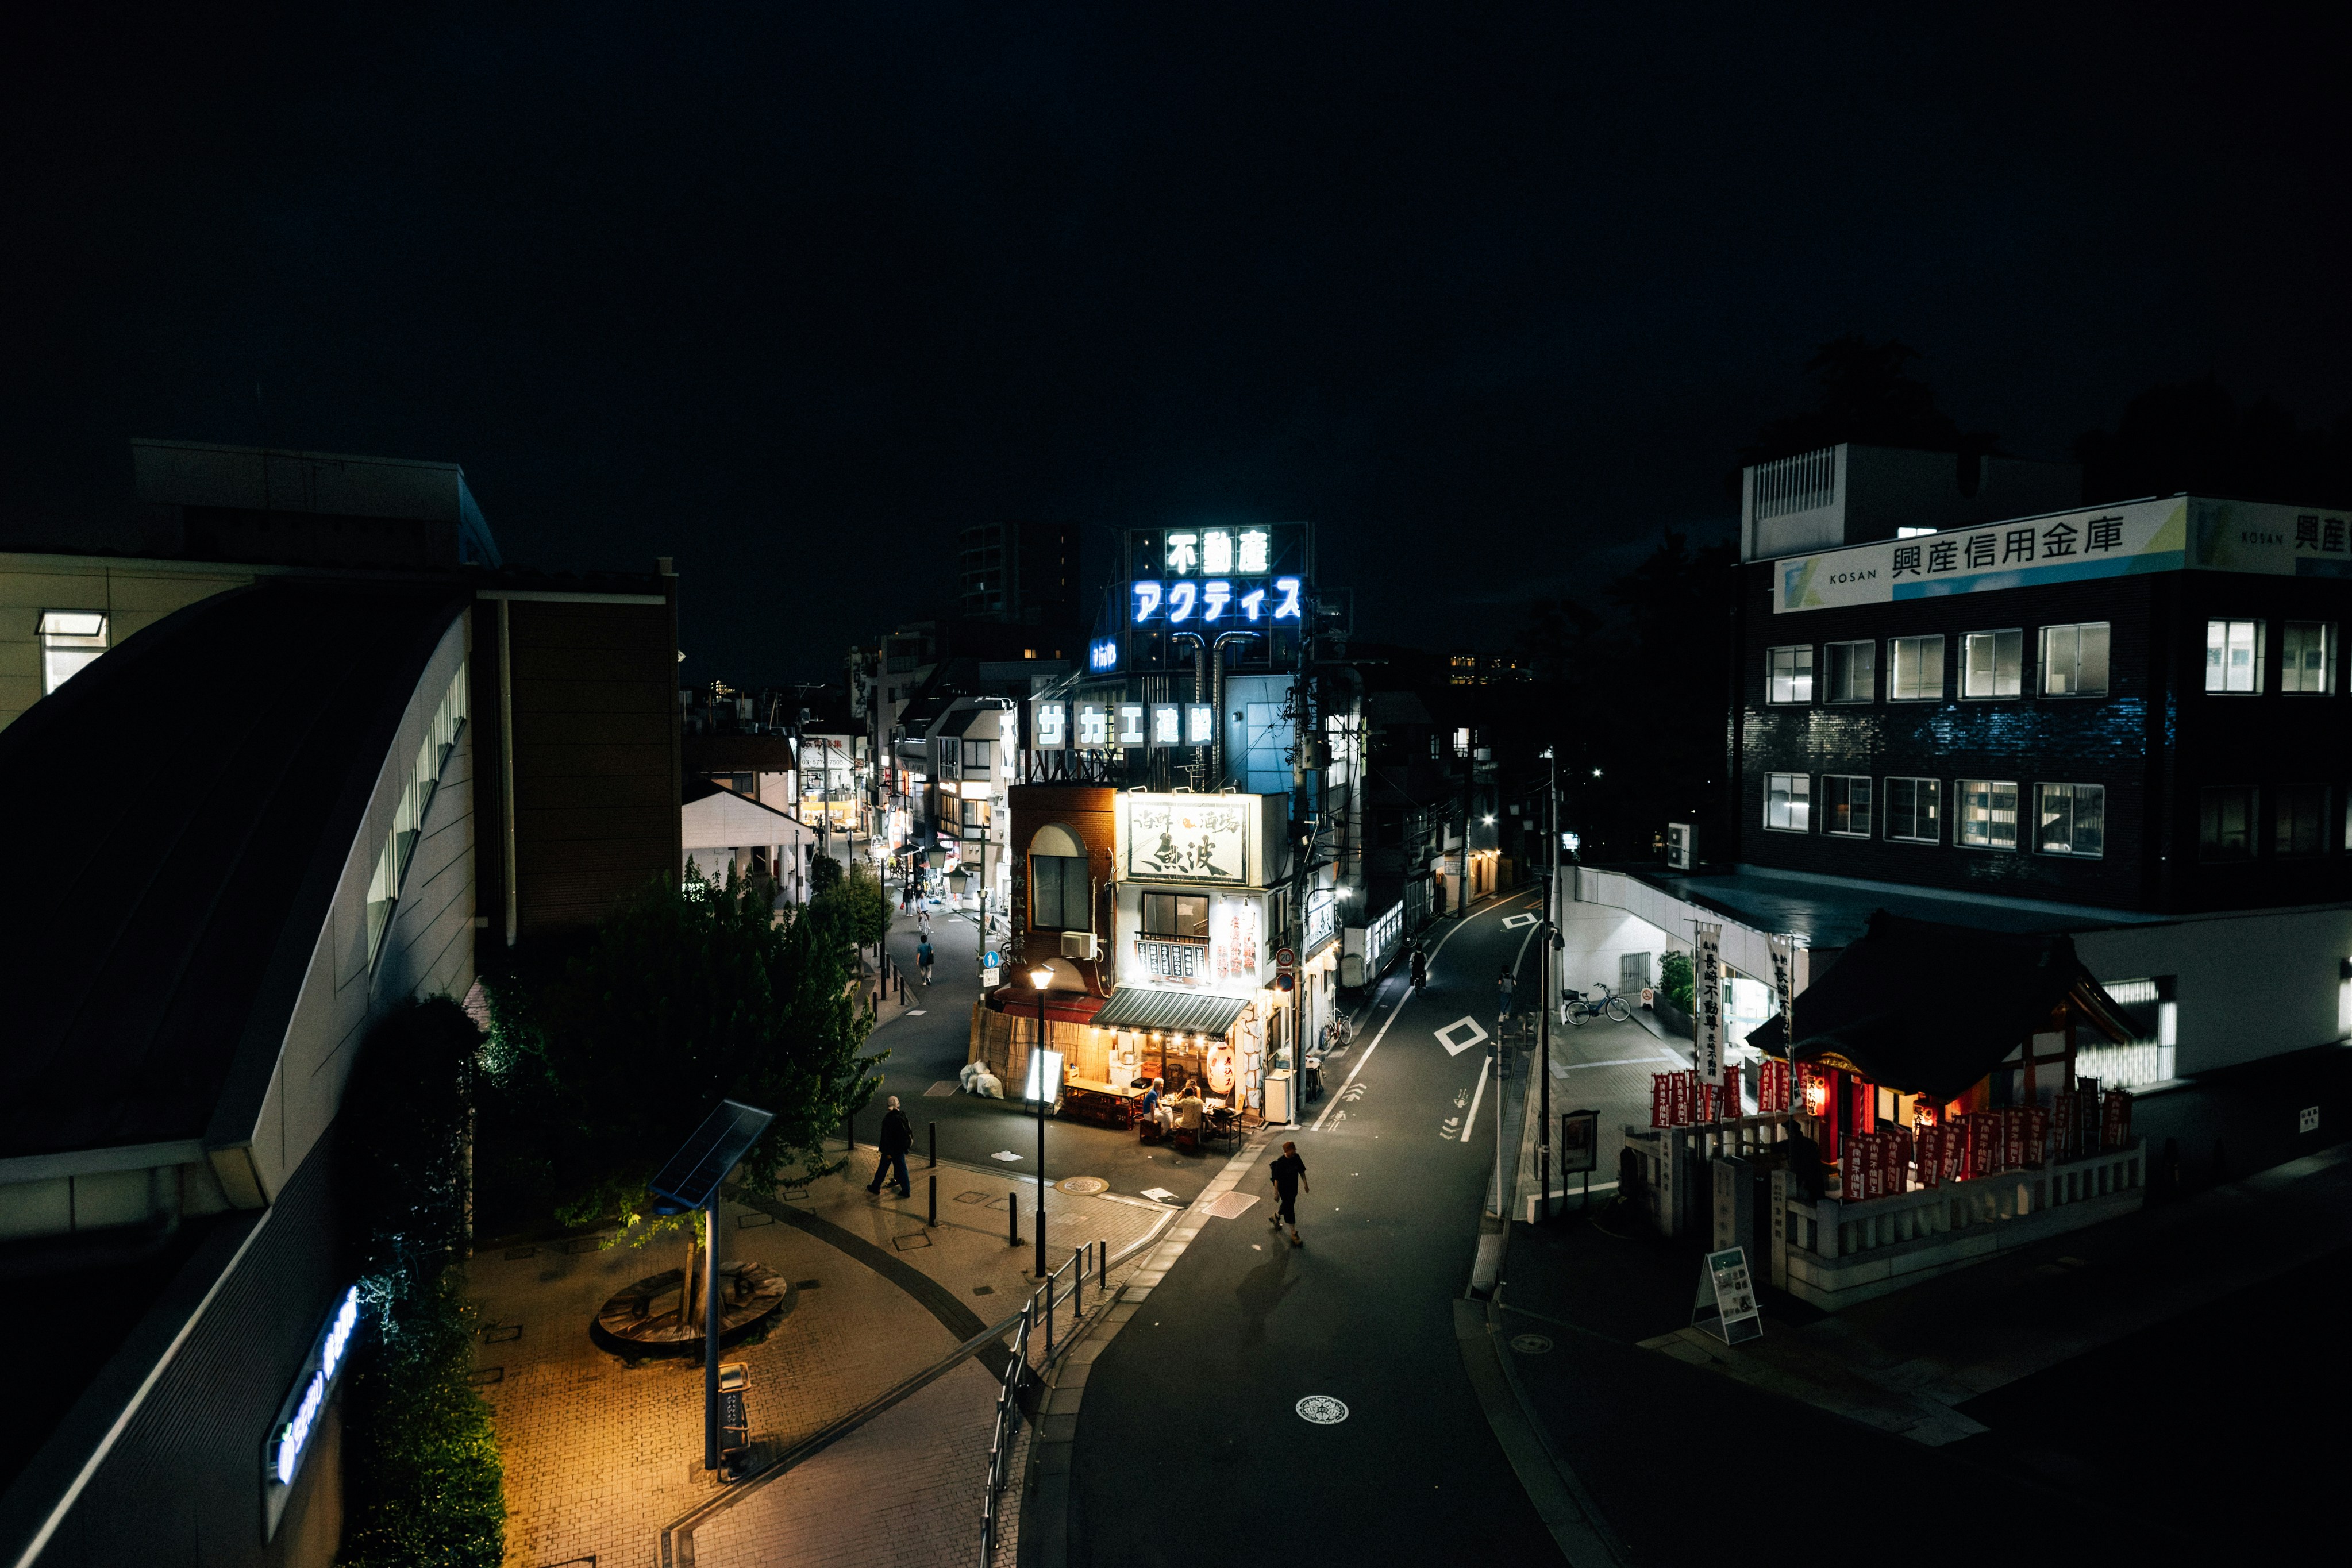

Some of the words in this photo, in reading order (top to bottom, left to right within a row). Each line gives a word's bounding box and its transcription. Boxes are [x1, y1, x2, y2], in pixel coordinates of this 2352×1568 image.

[1168, 530, 1268, 574] 不動産
[1892, 515, 2124, 579] 興産信用金庫
[2242, 532, 2282, 545] KOSAN
[2296, 515, 2352, 552] 興産
[1830, 569, 1877, 584] KOSAN
[1135, 580, 1301, 623] アクティス
[1134, 806, 1173, 833] 海鮮
[1199, 807, 1241, 834] 酒場
[1139, 833, 1233, 876] 魚波
[1280, 954, 1291, 962] 20
[1704, 954, 1718, 1030] 長崎不動尊
